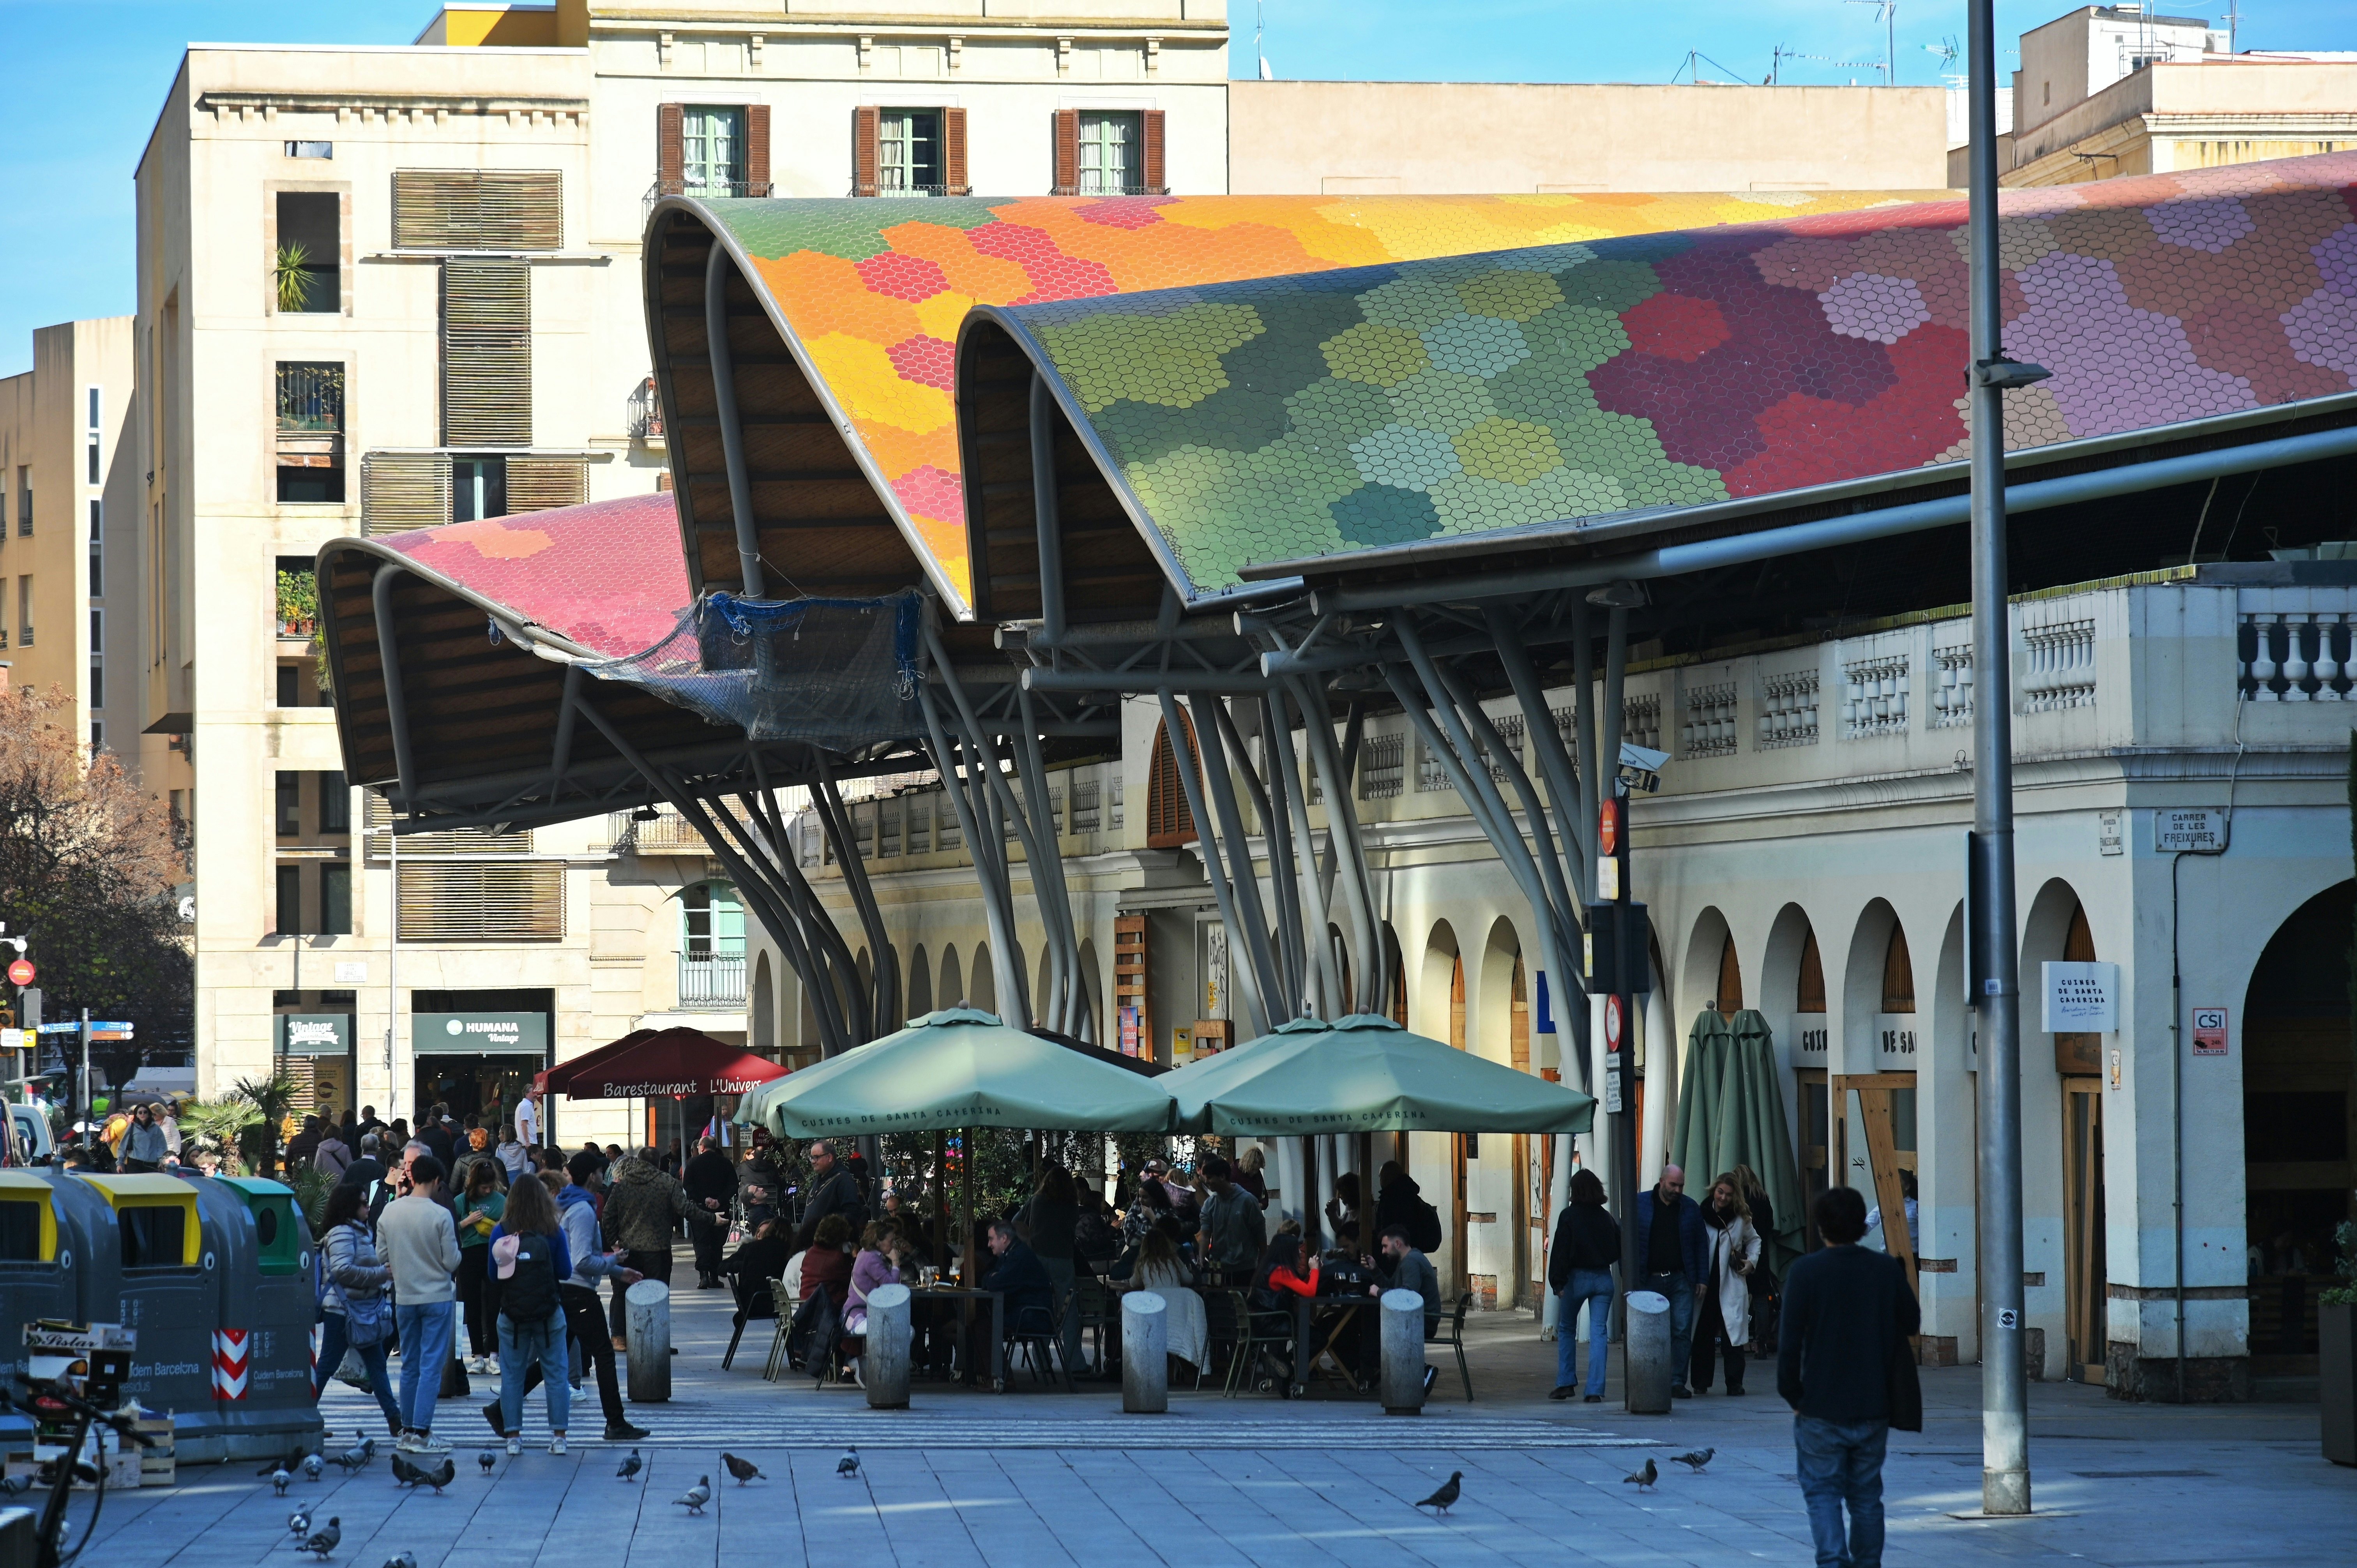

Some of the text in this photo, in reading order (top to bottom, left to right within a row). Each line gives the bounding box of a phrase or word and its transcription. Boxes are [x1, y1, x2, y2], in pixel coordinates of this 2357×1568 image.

[2164, 832, 2214, 843] FREIXURES
[288, 1021, 333, 1034] Vintage
[466, 1023, 519, 1032] HUMANA
[2198, 1014, 2222, 1028] CSI
[488, 1033, 519, 1044] Vintage
[1882, 1030, 1917, 1053] DE SA
[604, 1079, 697, 1097] Barestaurant
[802, 1117, 851, 1127] CUINES
[887, 1111, 926, 1121] SANTA
[1314, 1114, 1352, 1123] SANTA
